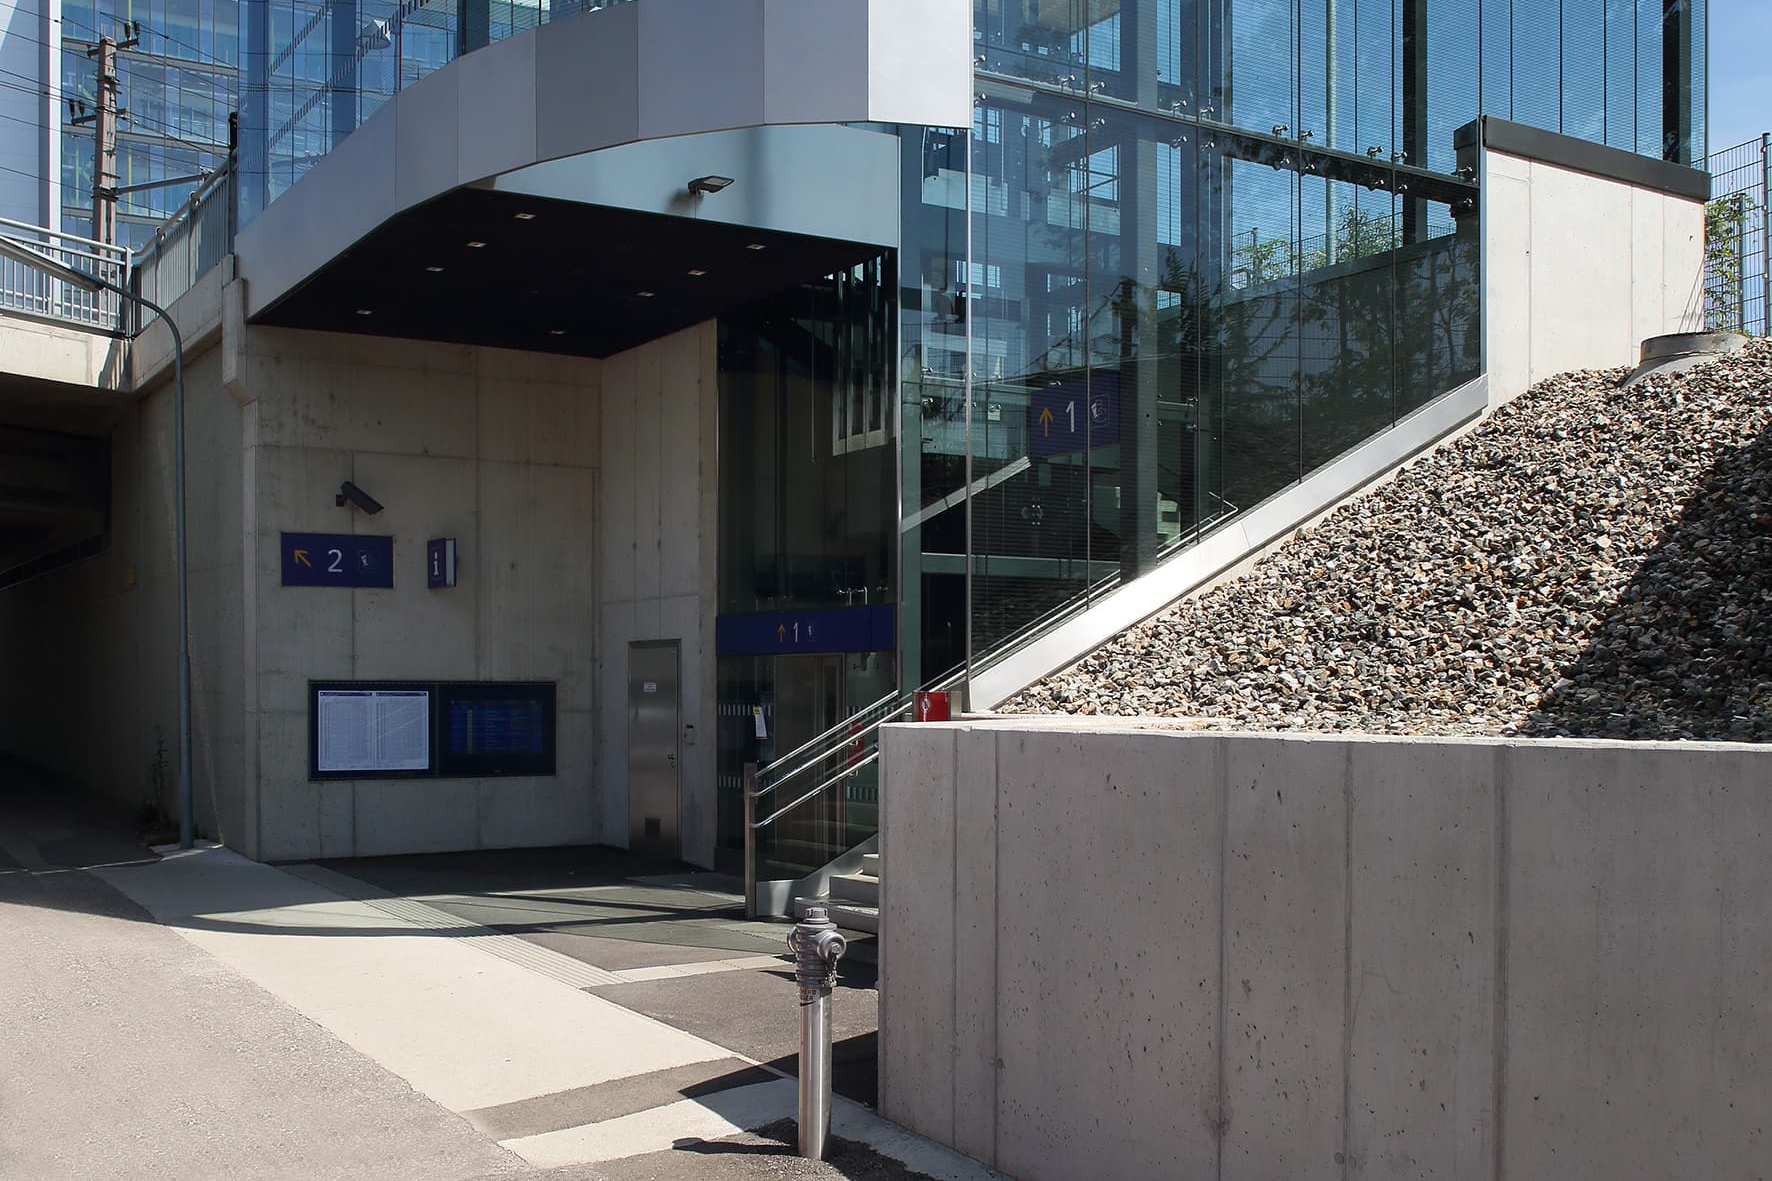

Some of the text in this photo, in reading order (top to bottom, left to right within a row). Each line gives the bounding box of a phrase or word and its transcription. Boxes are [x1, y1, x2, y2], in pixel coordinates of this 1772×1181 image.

[1065, 400, 1076, 434] 1
[327, 548, 344, 573] 2
[793, 622, 799, 643] 1
